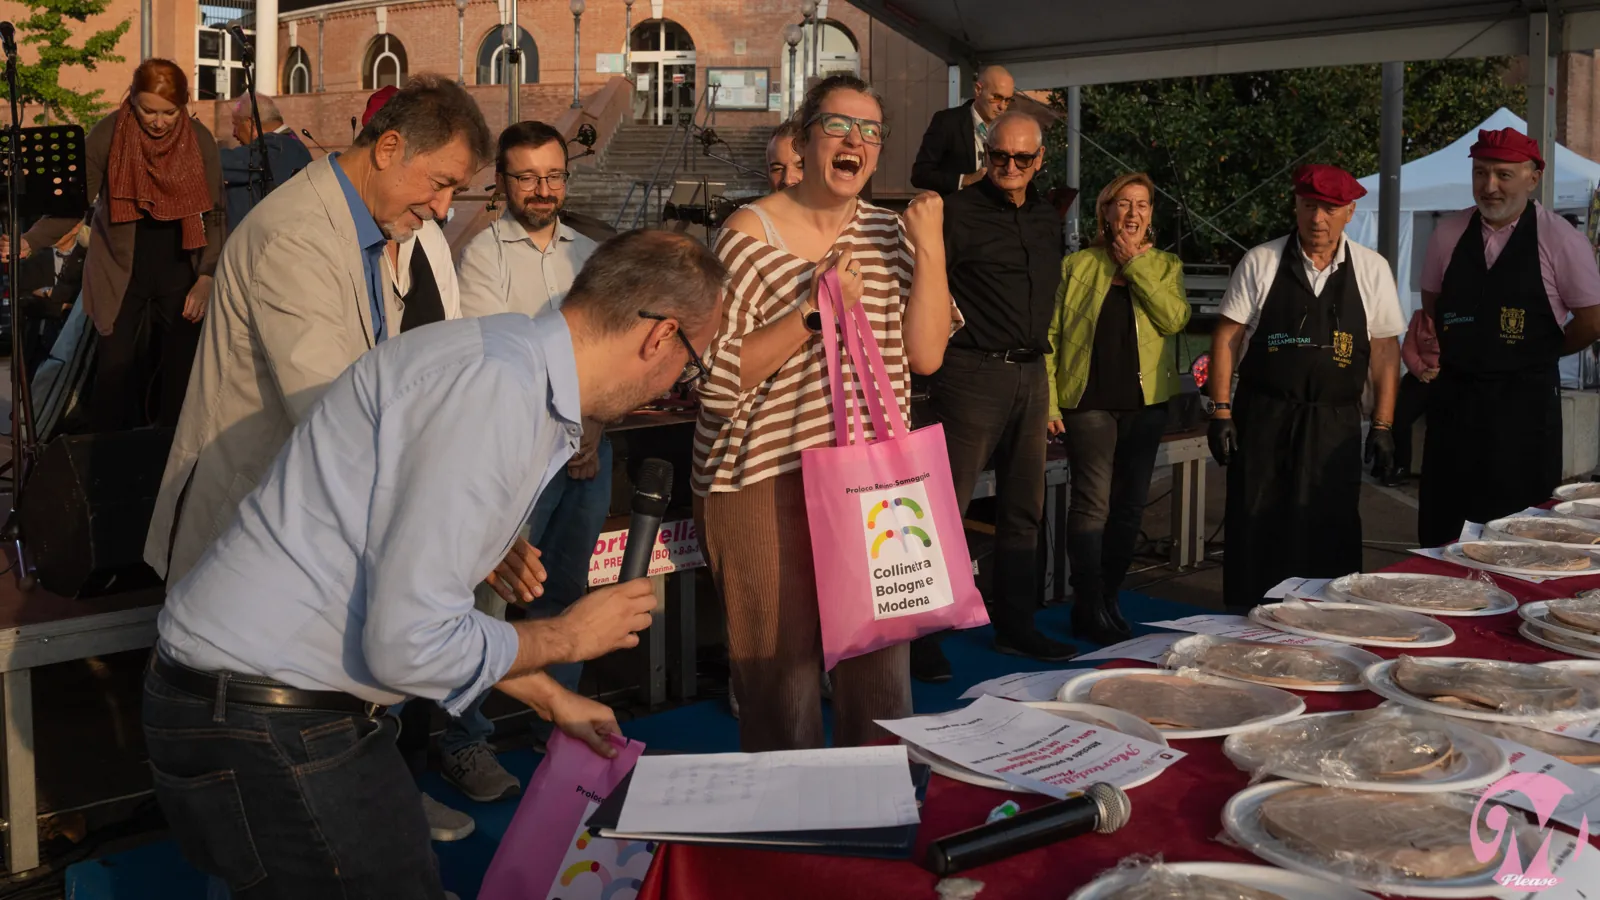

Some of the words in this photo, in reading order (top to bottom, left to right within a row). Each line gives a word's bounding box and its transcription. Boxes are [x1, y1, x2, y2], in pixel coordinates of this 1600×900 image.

[1268, 337, 1311, 347] SALSAMENTARI
[846, 485, 874, 494] Proloco
[604, 556, 622, 569] PRE
[652, 549, 671, 562] (BO)
[648, 565, 674, 574] teprima
[876, 579, 925, 597] Bologna
[925, 576, 934, 585] e
[878, 596, 930, 614] Modena
